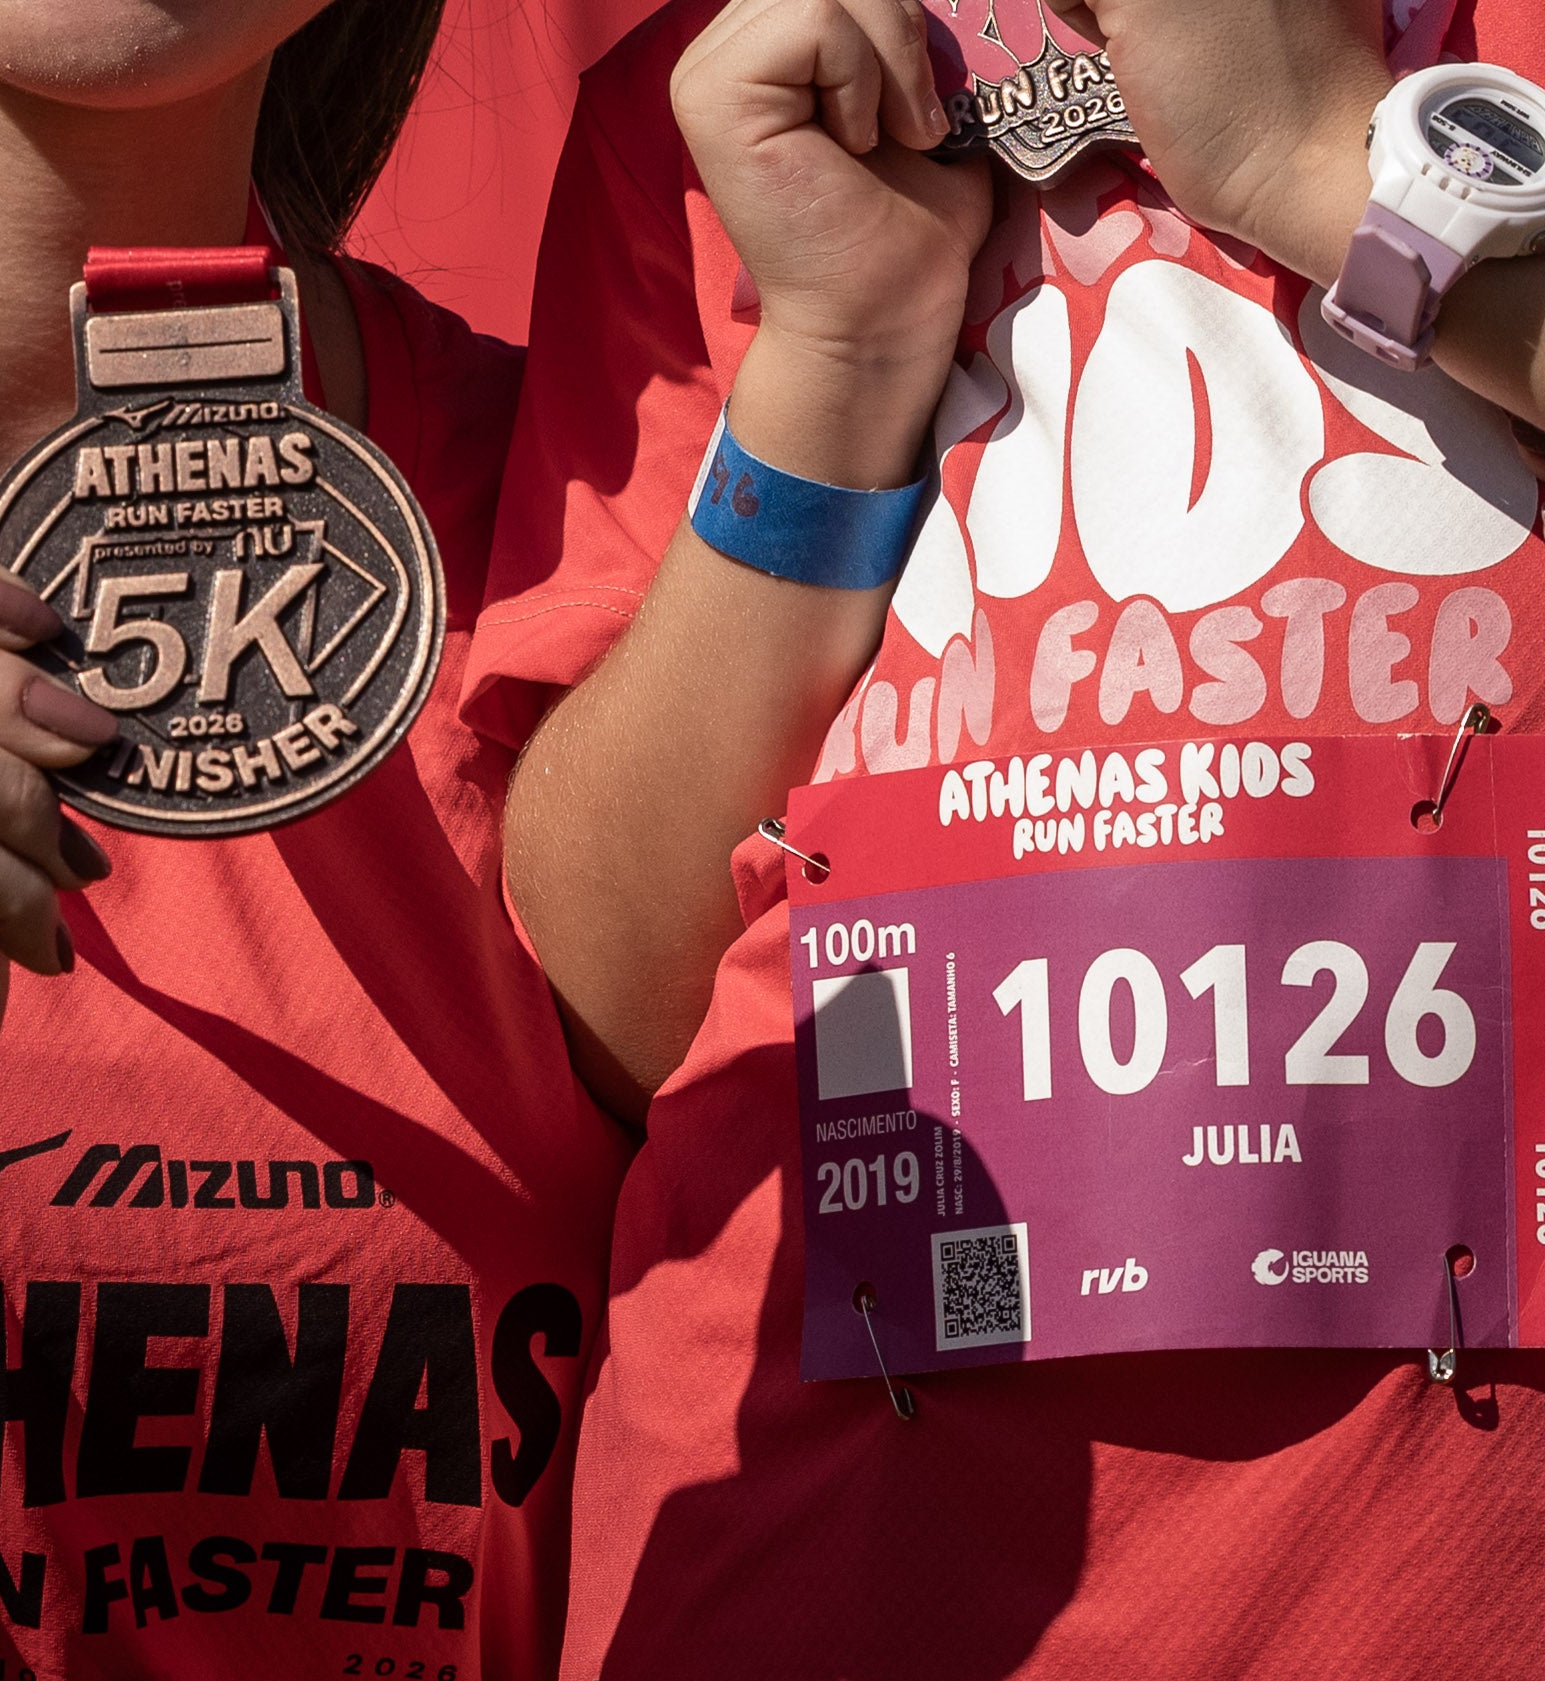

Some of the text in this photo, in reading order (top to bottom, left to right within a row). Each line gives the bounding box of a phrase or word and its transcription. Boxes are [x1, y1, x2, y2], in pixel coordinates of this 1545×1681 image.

[1041, 89, 1127, 138] 2026
[74, 431, 314, 499] ATHENAS
[106, 496, 284, 529] RUN FASTER
[93, 539, 186, 562] presented
[192, 538, 214, 555] by
[78, 562, 327, 710] 5K
[1030, 578, 1514, 734] FASTER
[106, 702, 358, 792] INISHER
[169, 712, 244, 738] 2026
[938, 741, 1316, 827] ATHENAS KIDS
[1012, 801, 1225, 860] RUN FASTER
[799, 918, 917, 970] 100m
[945, 960, 957, 1014] TAMANHO
[947, 1013, 960, 1068] CAMISETA:
[991, 940, 1478, 1103] 10126
[950, 1086, 961, 1117] SEXO:
[815, 1109, 918, 1144] NASCIMENTO
[1181, 1122, 1303, 1167] JULIA
[935, 1161, 945, 1188] CRUZ
[952, 1128, 963, 1183] 29/8/2019
[816, 1150, 921, 1215] 2019
[936, 1187, 946, 1217] JULIA
[954, 1183, 964, 1215] NASC:
[1079, 1257, 1149, 1296] rvb
[1292, 1250, 1369, 1267] IGUANA
[1292, 1267, 1369, 1284] SPORTS
[80, 1534, 476, 1635] FASTER
[342, 1654, 459, 1681] 2026
